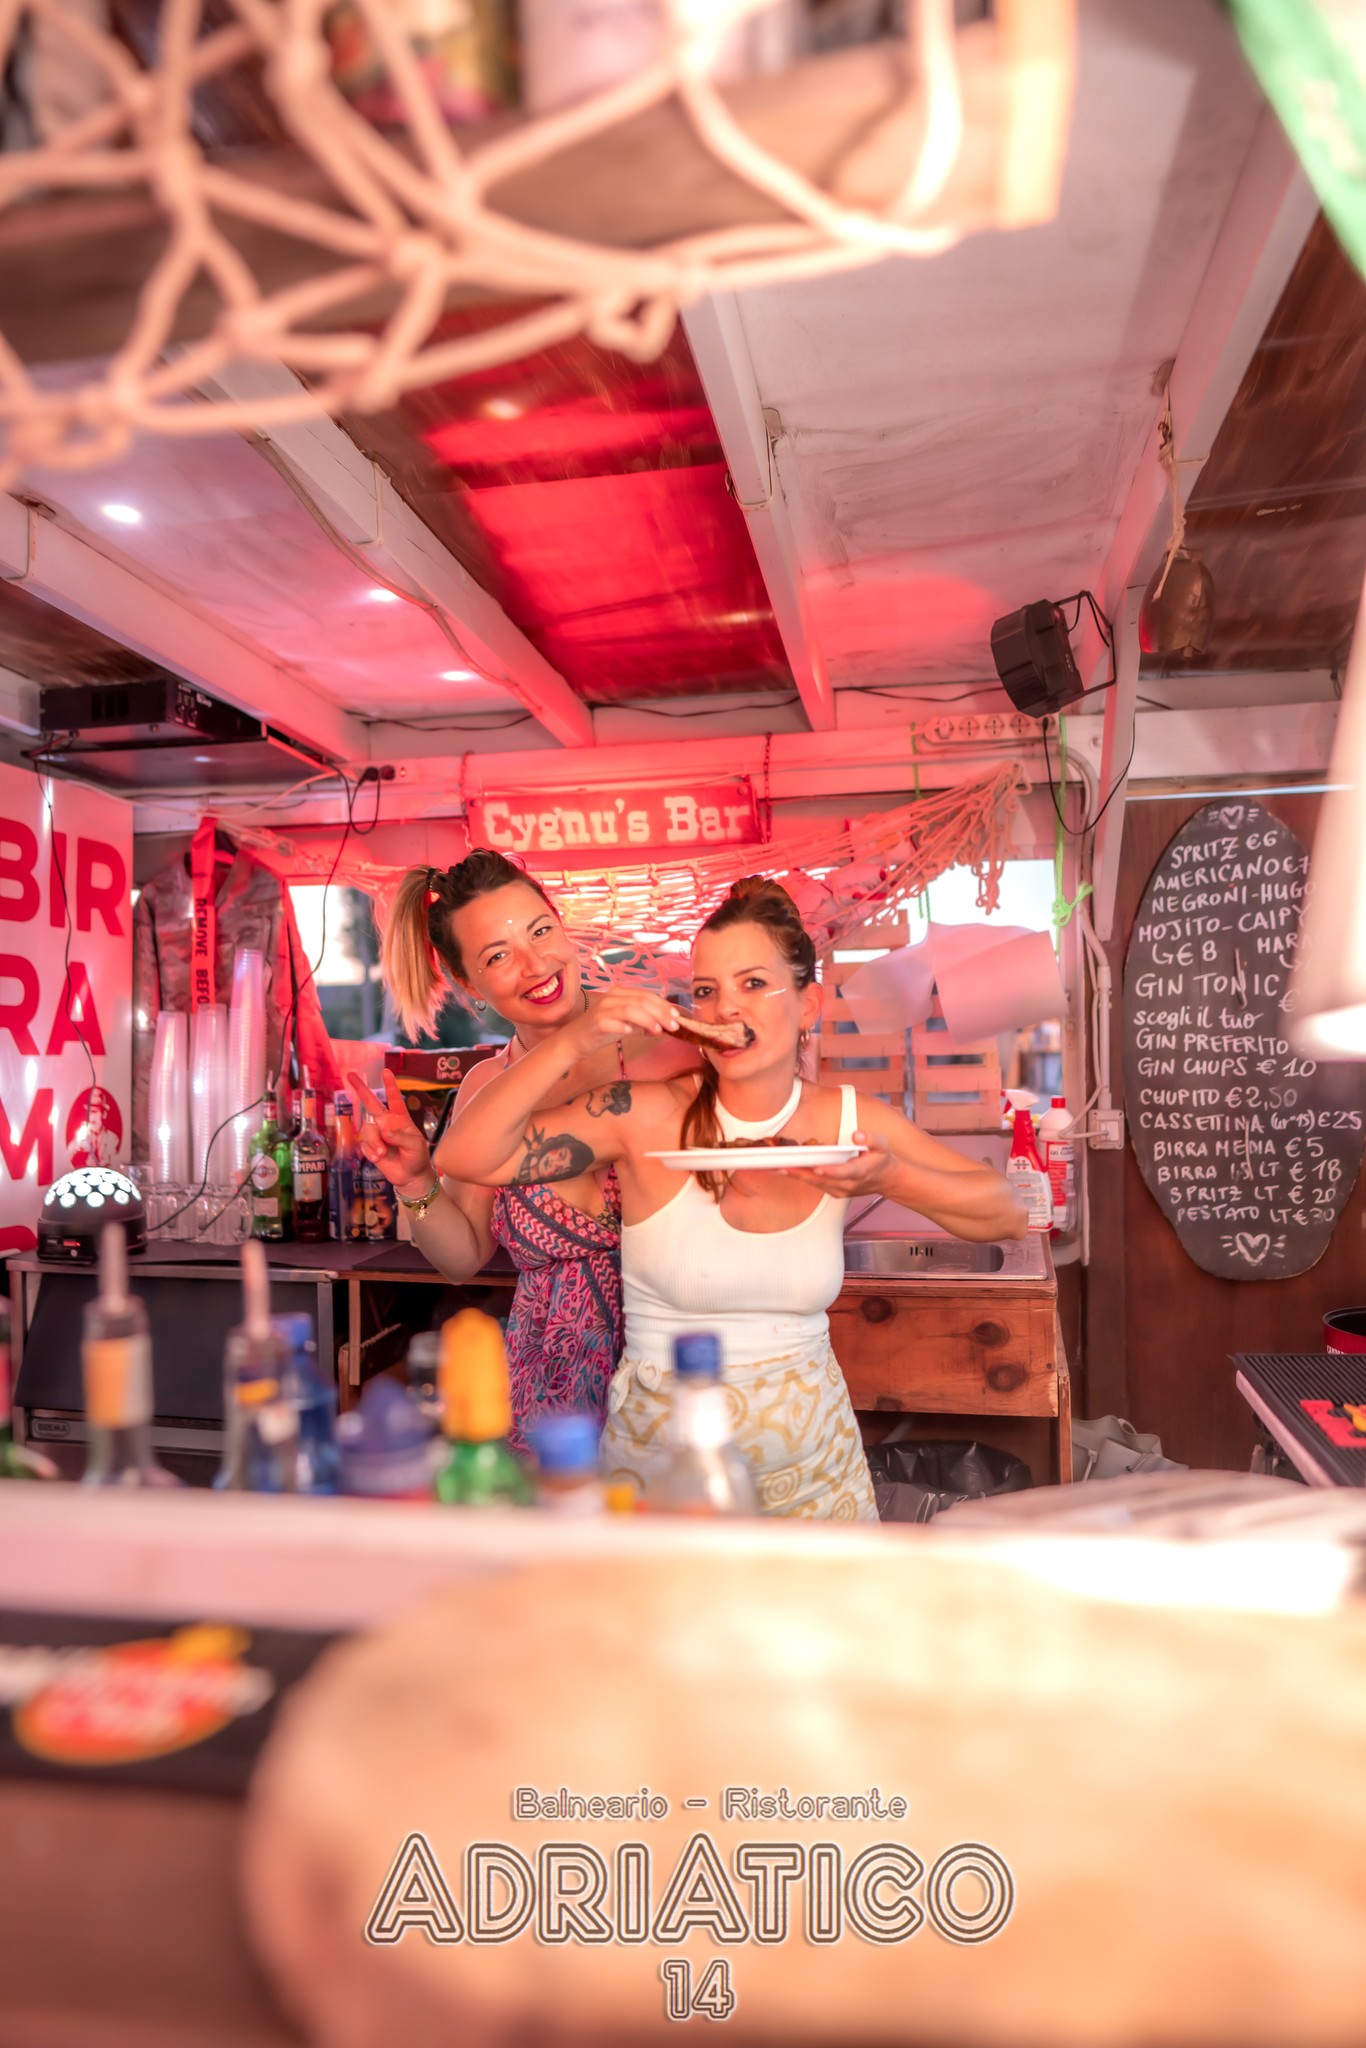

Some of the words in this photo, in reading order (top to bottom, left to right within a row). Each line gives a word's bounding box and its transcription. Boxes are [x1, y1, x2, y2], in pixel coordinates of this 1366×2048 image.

[482, 798, 650, 851] Cygnu's
[664, 795, 749, 842] Bar
[1170, 836, 1238, 870] SPRITZ
[195, 897, 208, 957] REMOVE
[1135, 973, 1183, 1000] GIN
[1193, 971, 1280, 996] TONIC
[1133, 1006, 1193, 1031] scegli
[1196, 1005, 1214, 1029] il
[1219, 1007, 1264, 1029] tuo
[1136, 1028, 1176, 1051] GIN
[1183, 1034, 1289, 1056] PREFERITO
[437, 1056, 460, 1071] GO
[1138, 1057, 1175, 1078] GIN
[1183, 1056, 1248, 1077] CHUPS
[1140, 1088, 1220, 1107] CHUPITO
[1139, 1110, 1265, 1134] CASSETTINA
[1153, 1140, 1208, 1161] BIRRA
[1215, 1139, 1276, 1158] MEDIA
[1157, 1165, 1218, 1185] BIRRA
[1259, 1160, 1280, 1177] LT
[1170, 1185, 1242, 1204] SPRITZ
[1254, 1185, 1280, 1202] LT
[1176, 1203, 1260, 1222] PESTATO
